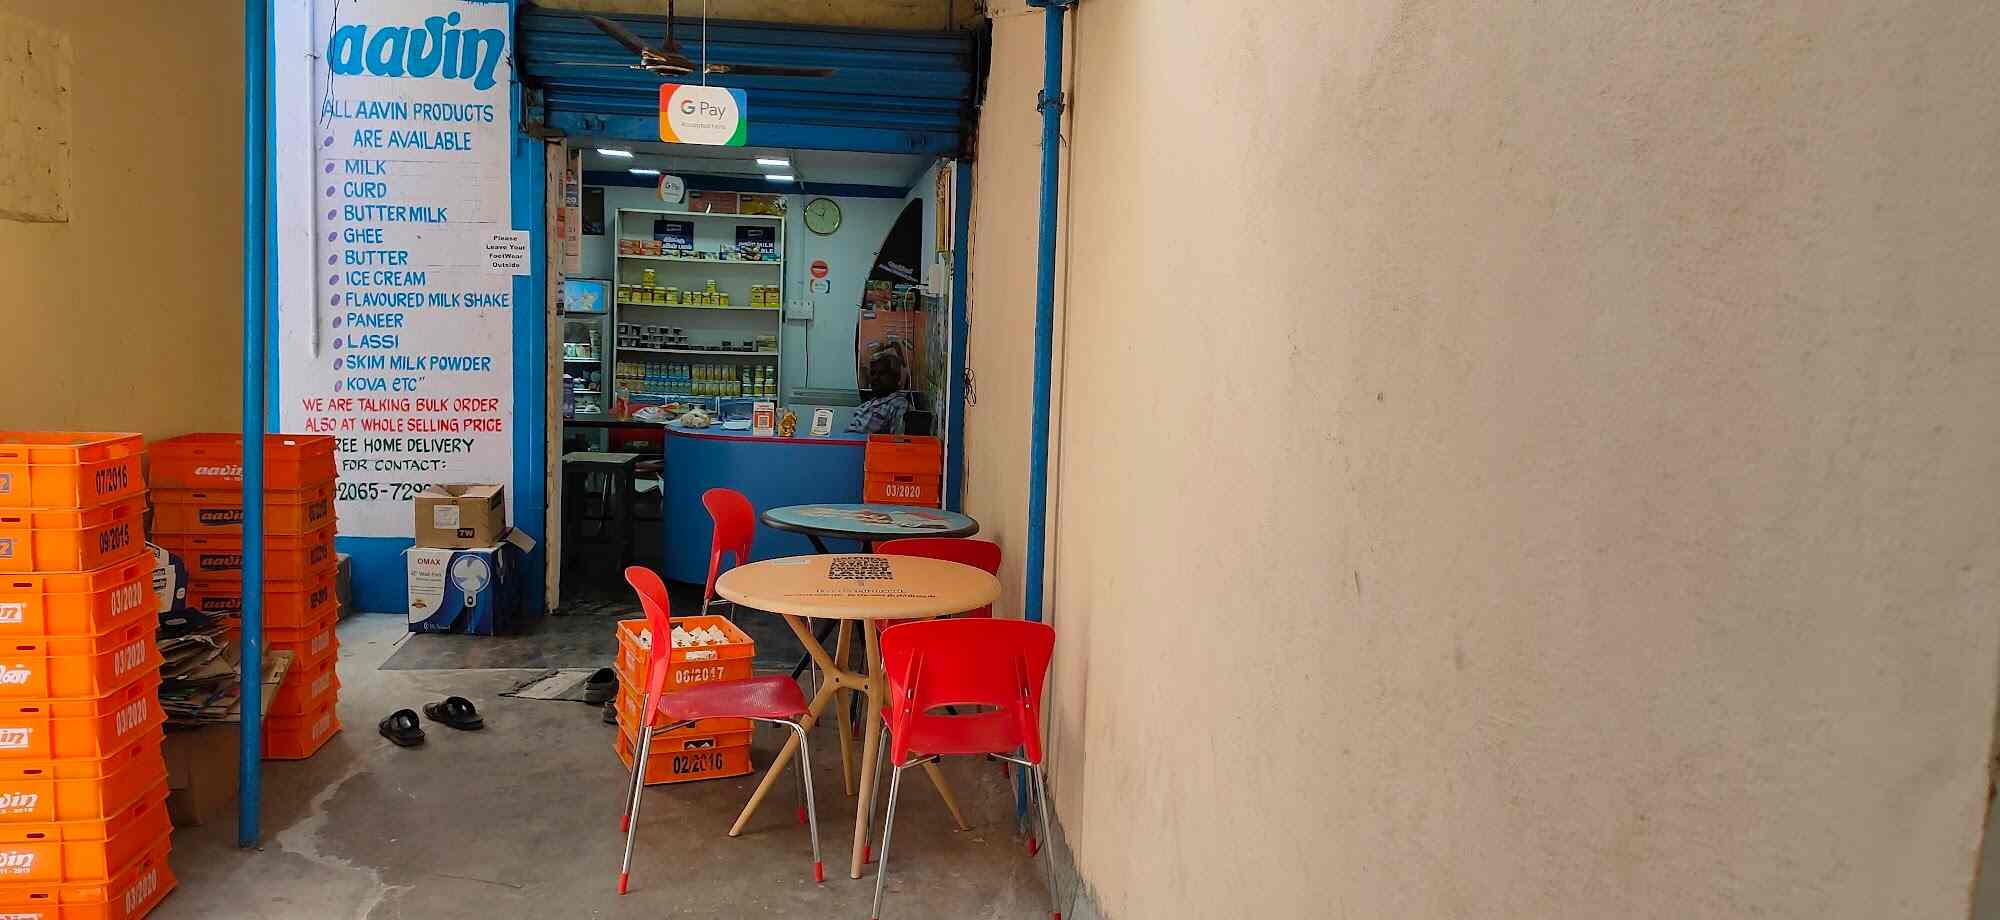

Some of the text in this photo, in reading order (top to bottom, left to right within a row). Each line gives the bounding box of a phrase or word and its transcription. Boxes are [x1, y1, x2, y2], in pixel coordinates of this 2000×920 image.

[326, 11, 505, 90] aavin
[323, 100, 494, 123] ALL AAVIN PRODUCTS
[699, 102, 726, 120] Pay
[353, 129, 472, 150] ARE AVAILABLE
[345, 159, 387, 175] MILK
[343, 181, 387, 198] CURD
[344, 228, 384, 244] GHEE
[345, 250, 408, 266] BUTTER
[345, 271, 426, 286] ICE CREAM
[345, 292, 510, 308] FLAVOURED MILK SHAKE
[346, 313, 404, 329] PANEER
[347, 335, 399, 349] LASSI
[346, 356, 491, 372] SKIM MILK POWDER
[346, 378, 387, 392] KOVA
[302, 398, 499, 412] WE ARE TALKING BULK ORDER
[305, 418, 502, 432] ALSO AT WHOLE SELLING PRICE
[335, 438, 475, 453] REE HOME DELIVERY
[342, 459, 447, 471] FOR CONTACT:
[95, 463, 129, 497] 07/2016
[886, 484, 921, 499] 03/2020
[417, 558, 440, 567] OMAX
[111, 582, 143, 617] 03/2020
[114, 640, 145, 675] 03/2020
[116, 699, 147, 736] 03/2020
[673, 752, 723, 775] 02/2016
[126, 870, 156, 915] 03/2020
